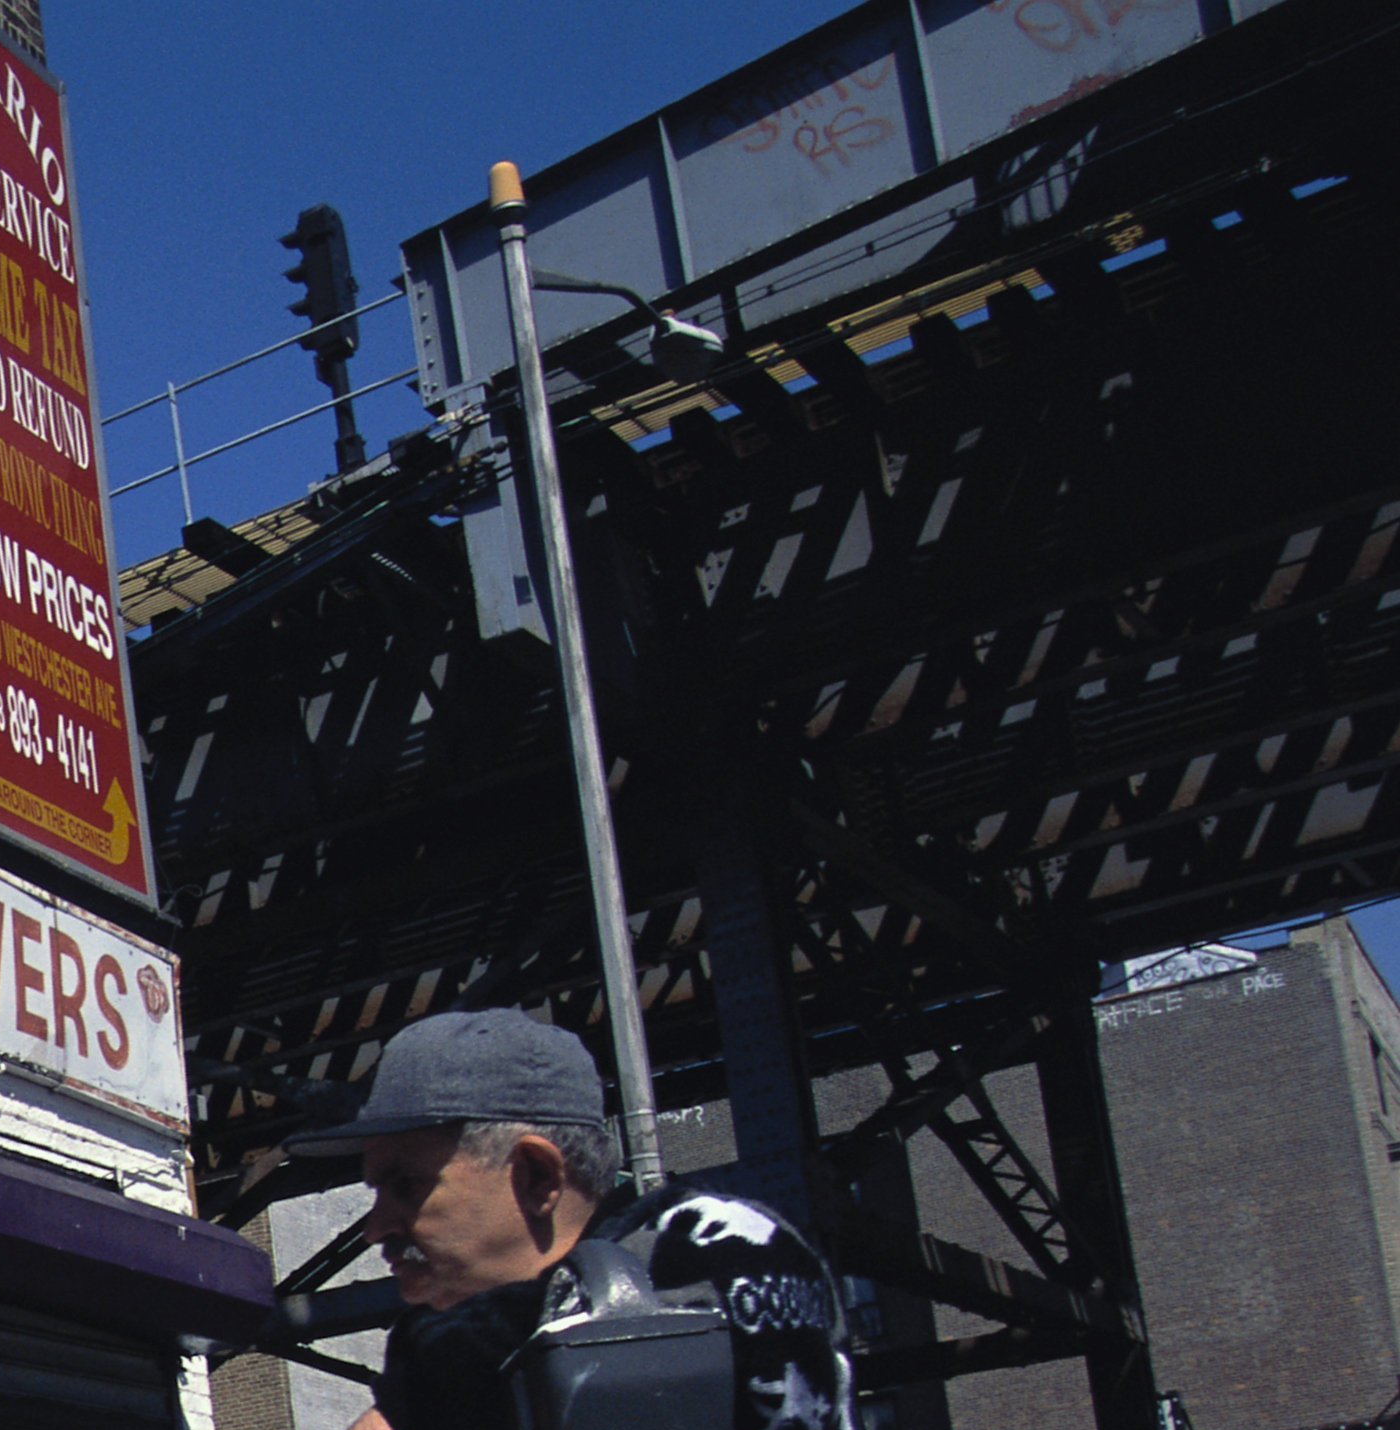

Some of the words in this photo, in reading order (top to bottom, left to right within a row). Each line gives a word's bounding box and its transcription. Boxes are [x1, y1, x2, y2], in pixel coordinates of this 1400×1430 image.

[34, 277, 86, 397] TAX
[8, 356, 90, 470] REFUND
[49, 470, 104, 566] FILING
[25, 549, 114, 661] PRICES
[2, 619, 95, 715] WESTCHESTER
[44, 806, 68, 836] THE
[67, 818, 114, 858] CORNER
